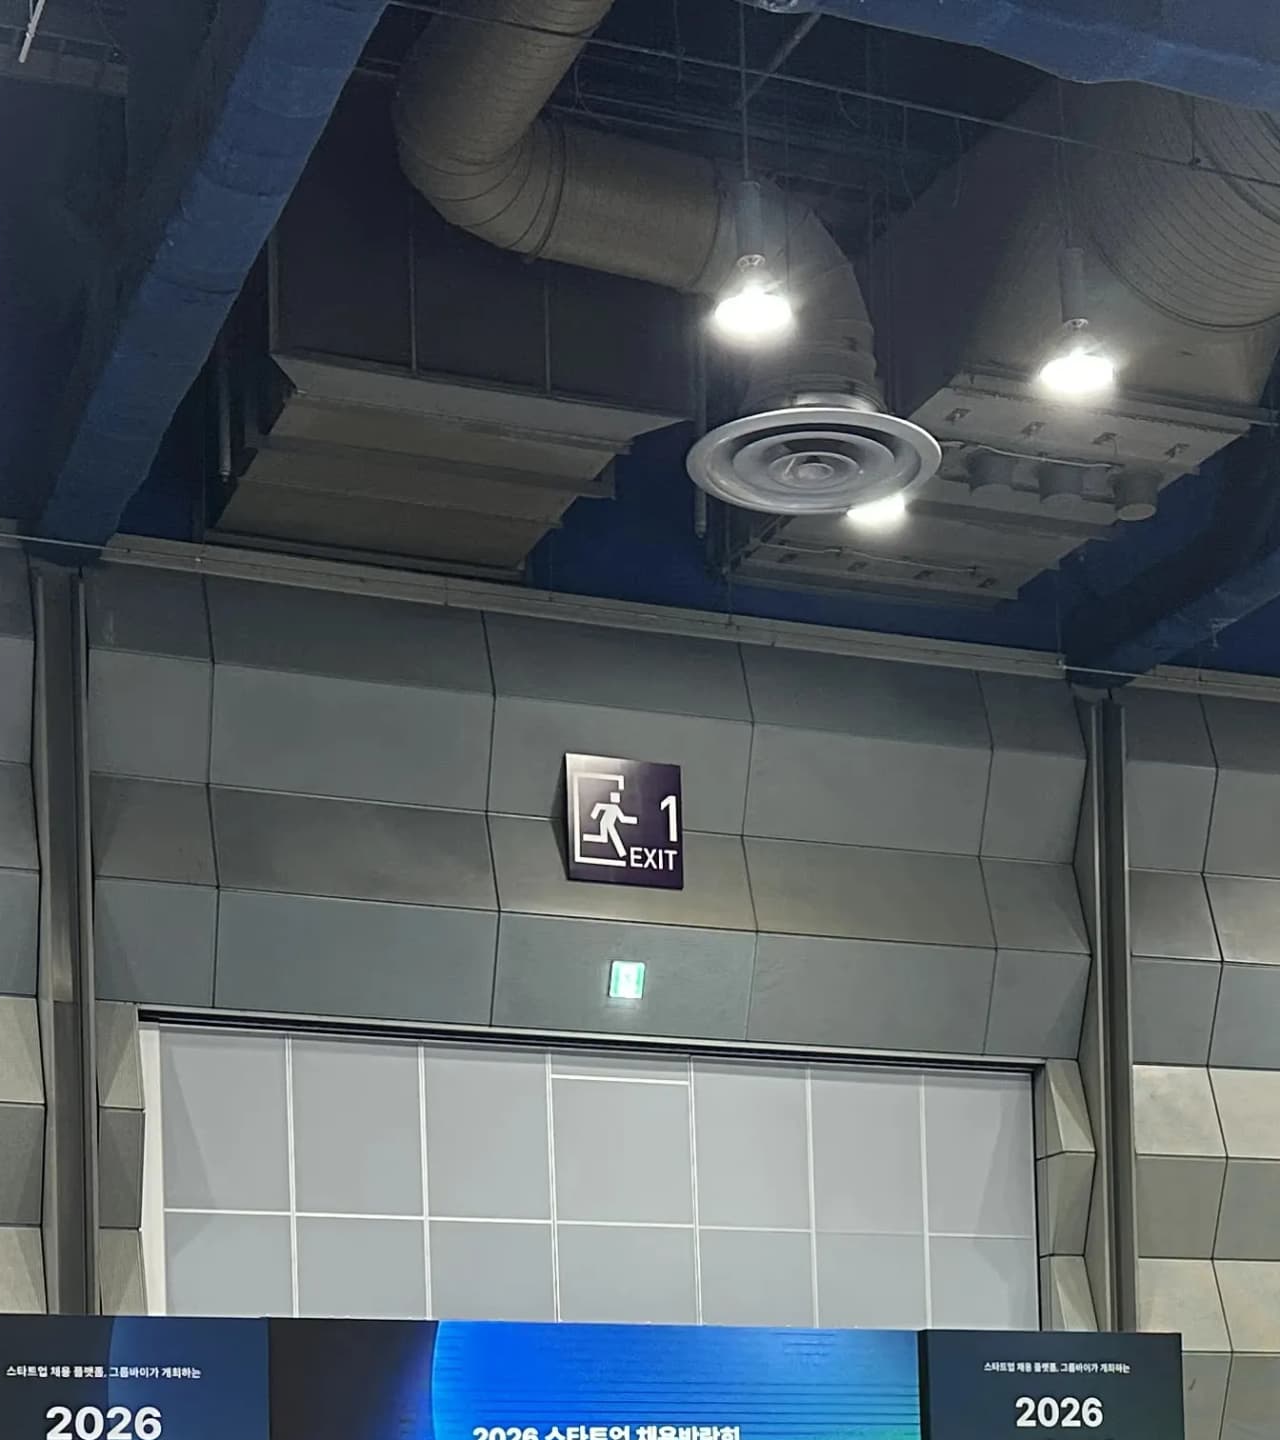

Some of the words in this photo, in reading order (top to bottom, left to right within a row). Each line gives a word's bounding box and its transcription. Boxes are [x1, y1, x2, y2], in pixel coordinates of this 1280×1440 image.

[660, 795, 678, 842] 1
[630, 847, 677, 871] EXIT
[6, 1365, 48, 1378] 스타트업
[50, 1365, 71, 1378] 채용
[109, 1365, 159, 1379] 그룹바이가
[983, 1362, 1015, 1373] 스타트업
[46, 1406, 162, 1440] 2026
[1015, 1397, 1103, 1428] 2026
